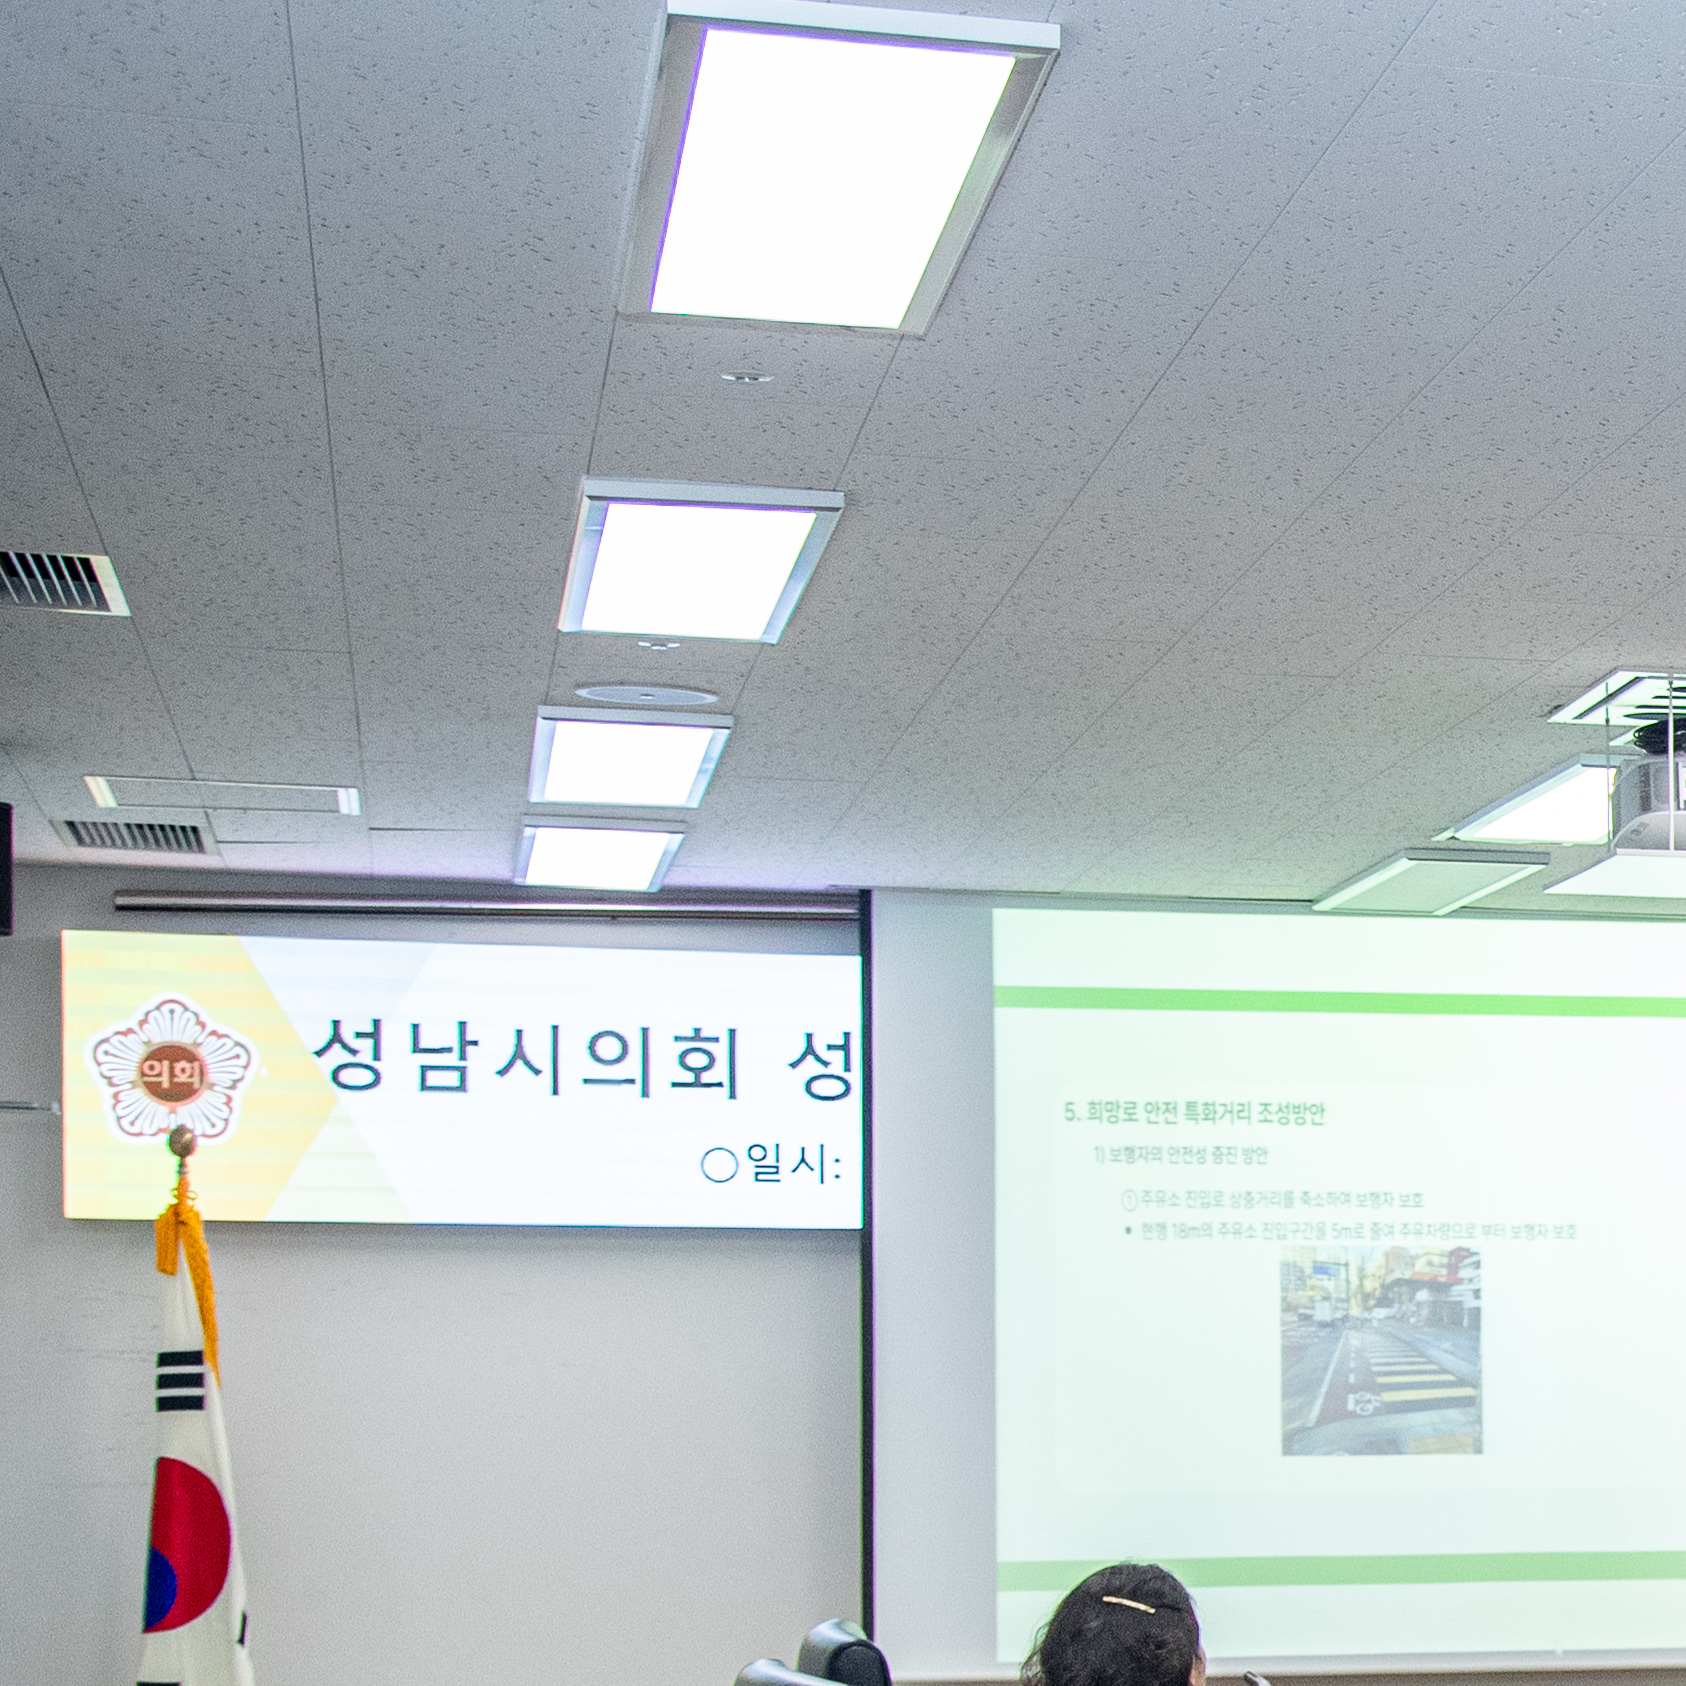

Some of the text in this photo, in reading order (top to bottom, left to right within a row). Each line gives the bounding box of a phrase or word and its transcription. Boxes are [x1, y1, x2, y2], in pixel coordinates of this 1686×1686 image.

[312, 1017, 739, 1101] 성남시의회
[142, 1060, 201, 1089] 의회
[1064, 1100, 1326, 1127] 5. 희망로 안전 특화거리 조성방안
[1109, 1145, 1164, 1165] 보행자의
[1167, 1145, 1207, 1165] 안전성
[1211, 1146, 1238, 1165] 증진
[1241, 1146, 1269, 1165] 방안
[1140, 1189, 1181, 1209] 주유소
[1184, 1190, 1225, 1209] 진입로
[1355, 1191, 1395, 1210] 보행자
[1398, 1191, 1425, 1208] 보호
[1217, 1221, 1257, 1240] 주유소
[1330, 1221, 1365, 1240] 5m로
[1510, 1223, 1549, 1241] 보행자
[1552, 1223, 1578, 1240] 보호
